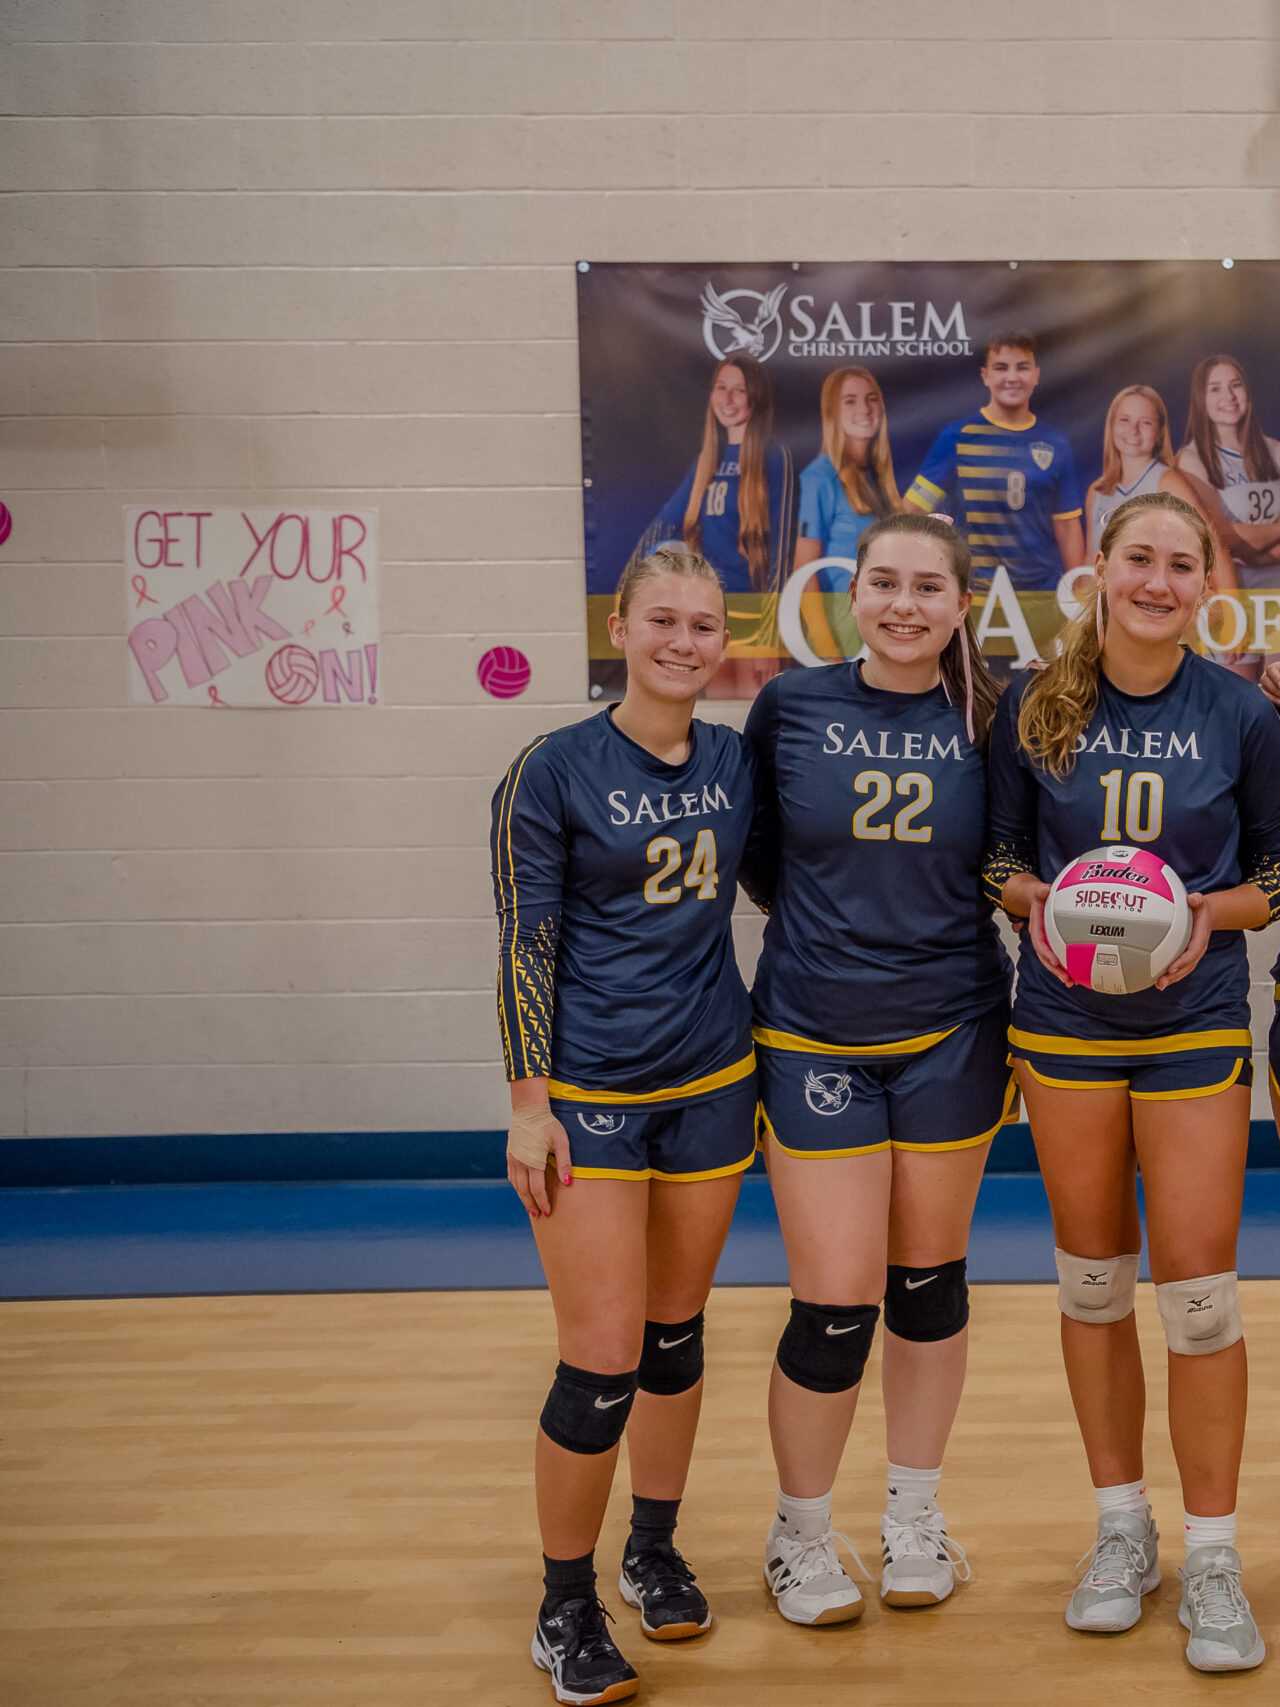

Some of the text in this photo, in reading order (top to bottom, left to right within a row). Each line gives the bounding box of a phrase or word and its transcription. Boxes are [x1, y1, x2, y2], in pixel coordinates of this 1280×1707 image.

[789, 295, 971, 342] SALEM
[788, 341, 973, 356] CHRISTIAN SCHOOL
[706, 481, 728, 516] 18
[1008, 471, 1026, 510] 8
[1248, 489, 1274, 521] 32
[134, 511, 366, 583] GET YOUR
[127, 574, 292, 703] PINK
[823, 722, 964, 761] SALEM
[607, 782, 732, 826] SALEM
[853, 770, 934, 843] 22
[1101, 769, 1164, 842] 10
[644, 829, 719, 905] 24
[1080, 864, 1150, 885] Baden
[1075, 903, 1143, 914] FOUNDATION
[1089, 924, 1125, 937] LEXUM
